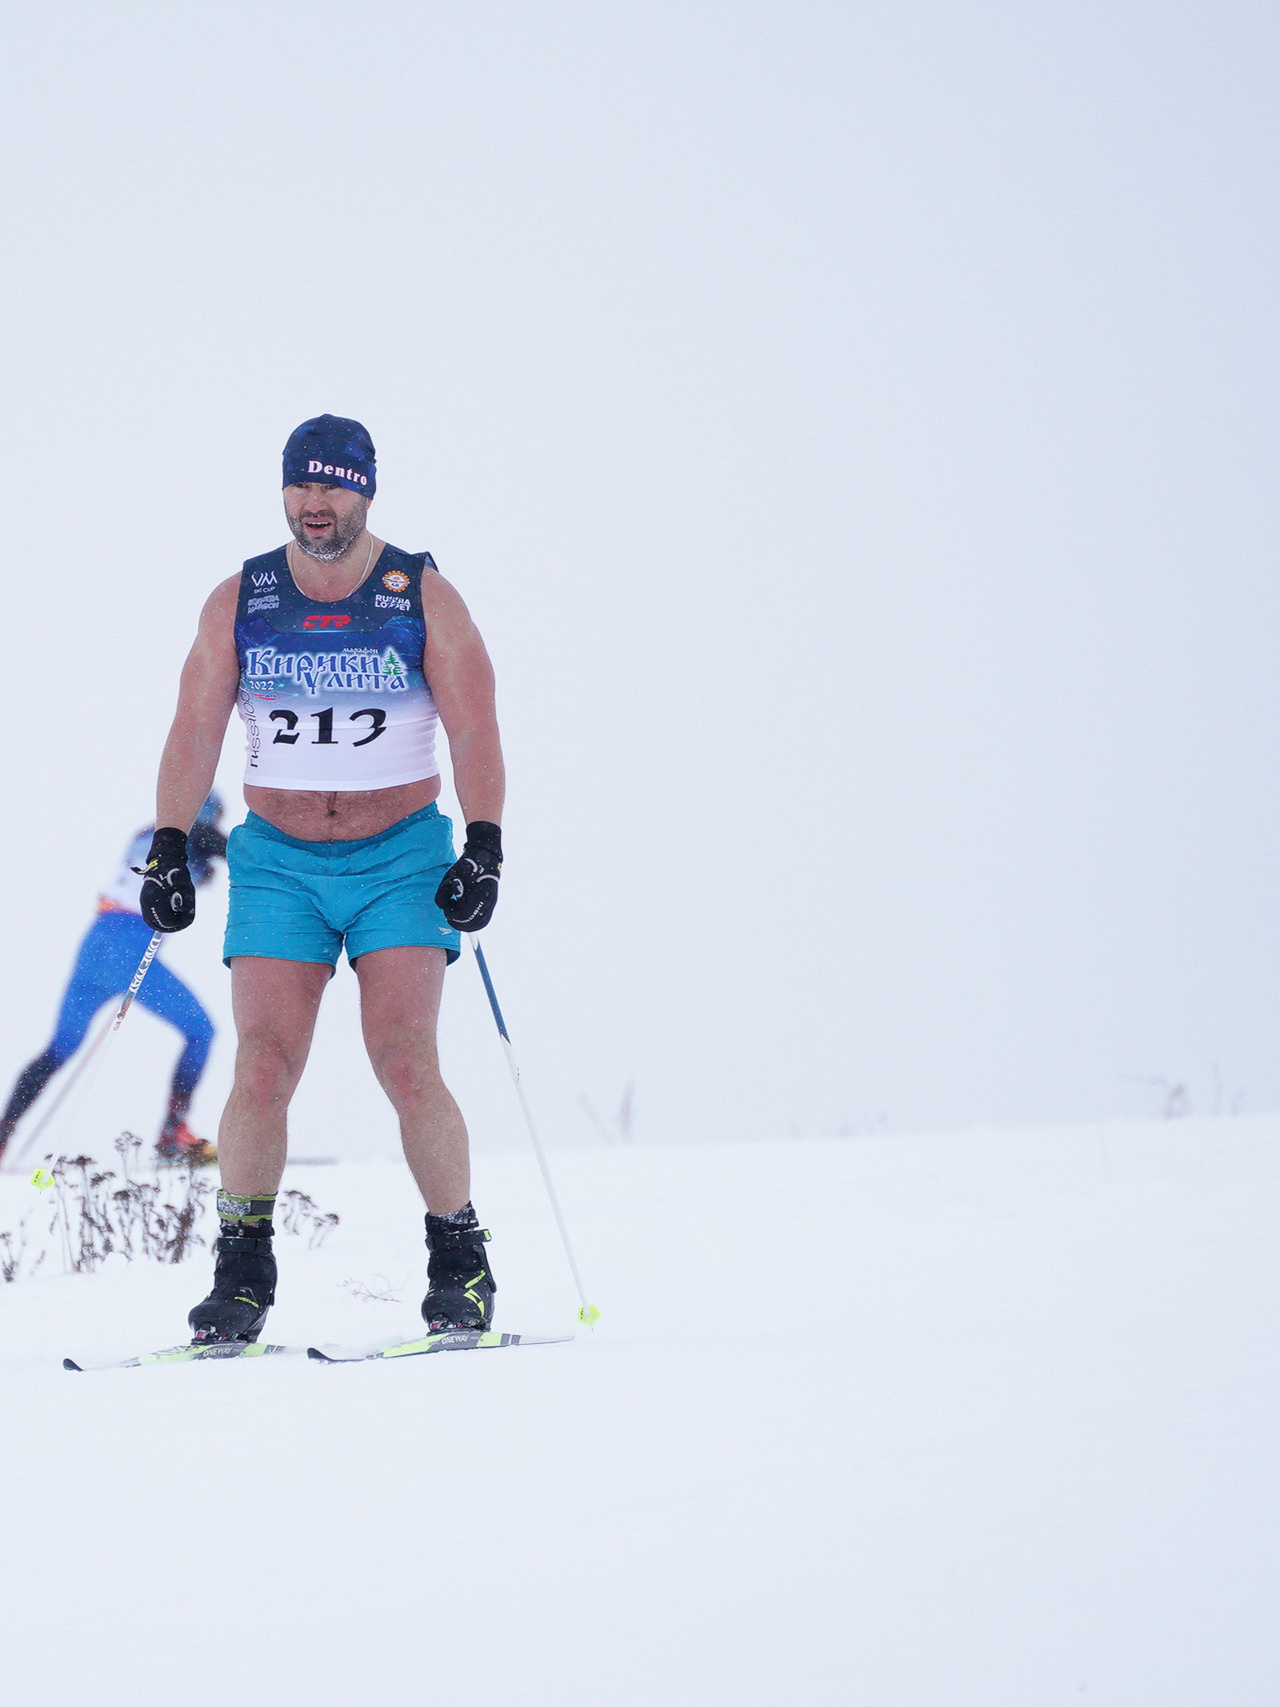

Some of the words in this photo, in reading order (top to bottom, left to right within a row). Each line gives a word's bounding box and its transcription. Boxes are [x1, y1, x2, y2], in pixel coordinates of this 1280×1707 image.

[307, 460, 367, 485] Dentro
[249, 680, 274, 691] 2022
[269, 707, 387, 748] 213
[441, 1335, 469, 1345] ONEWAY
[203, 1347, 233, 1357] ONEWAY
